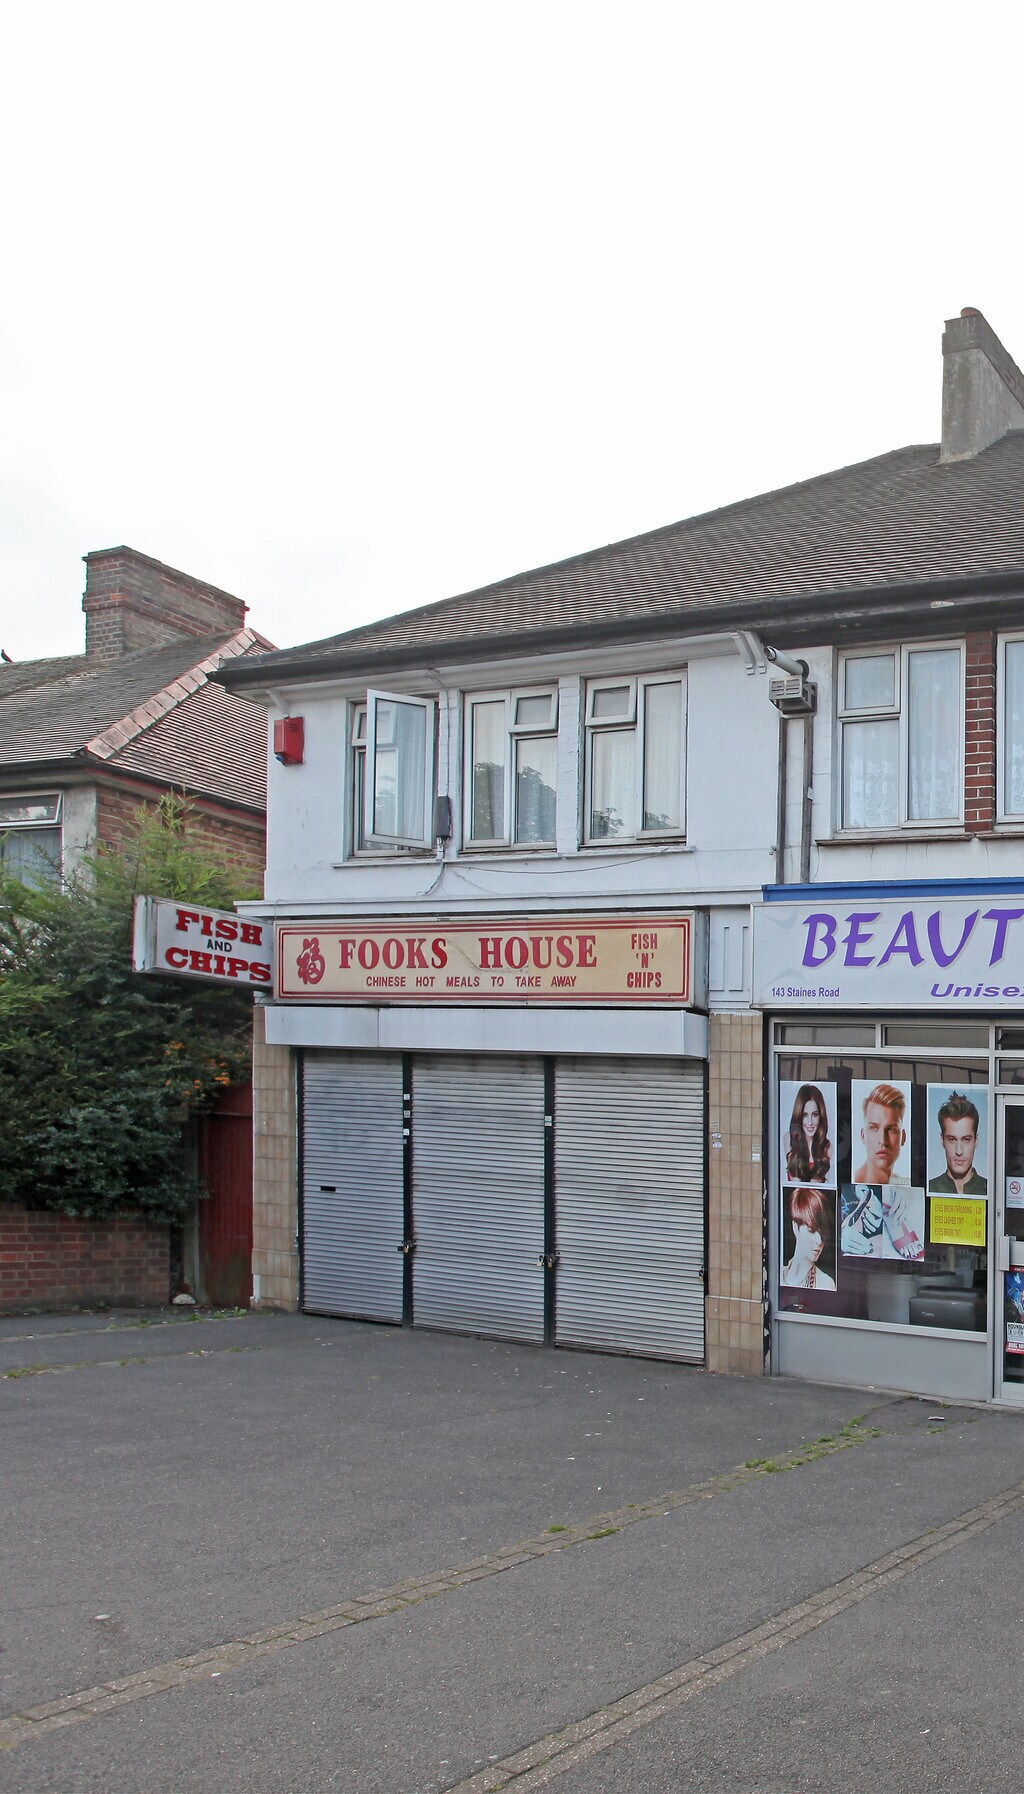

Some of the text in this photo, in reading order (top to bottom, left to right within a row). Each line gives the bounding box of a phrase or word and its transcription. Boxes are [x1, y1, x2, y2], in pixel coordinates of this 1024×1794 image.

[176, 909, 262, 946] FISH
[206, 939, 232, 952] AND
[631, 933, 658, 950] FISH
[338, 935, 598, 970] FOOKS HOUSE
[165, 947, 271, 982] CHIPS
[366, 975, 577, 987] CHINESE HOT MEALS TO TAKE AWAY
[626, 971, 662, 988] CHIPS
[771, 987, 840, 998] 143 Staines Road
